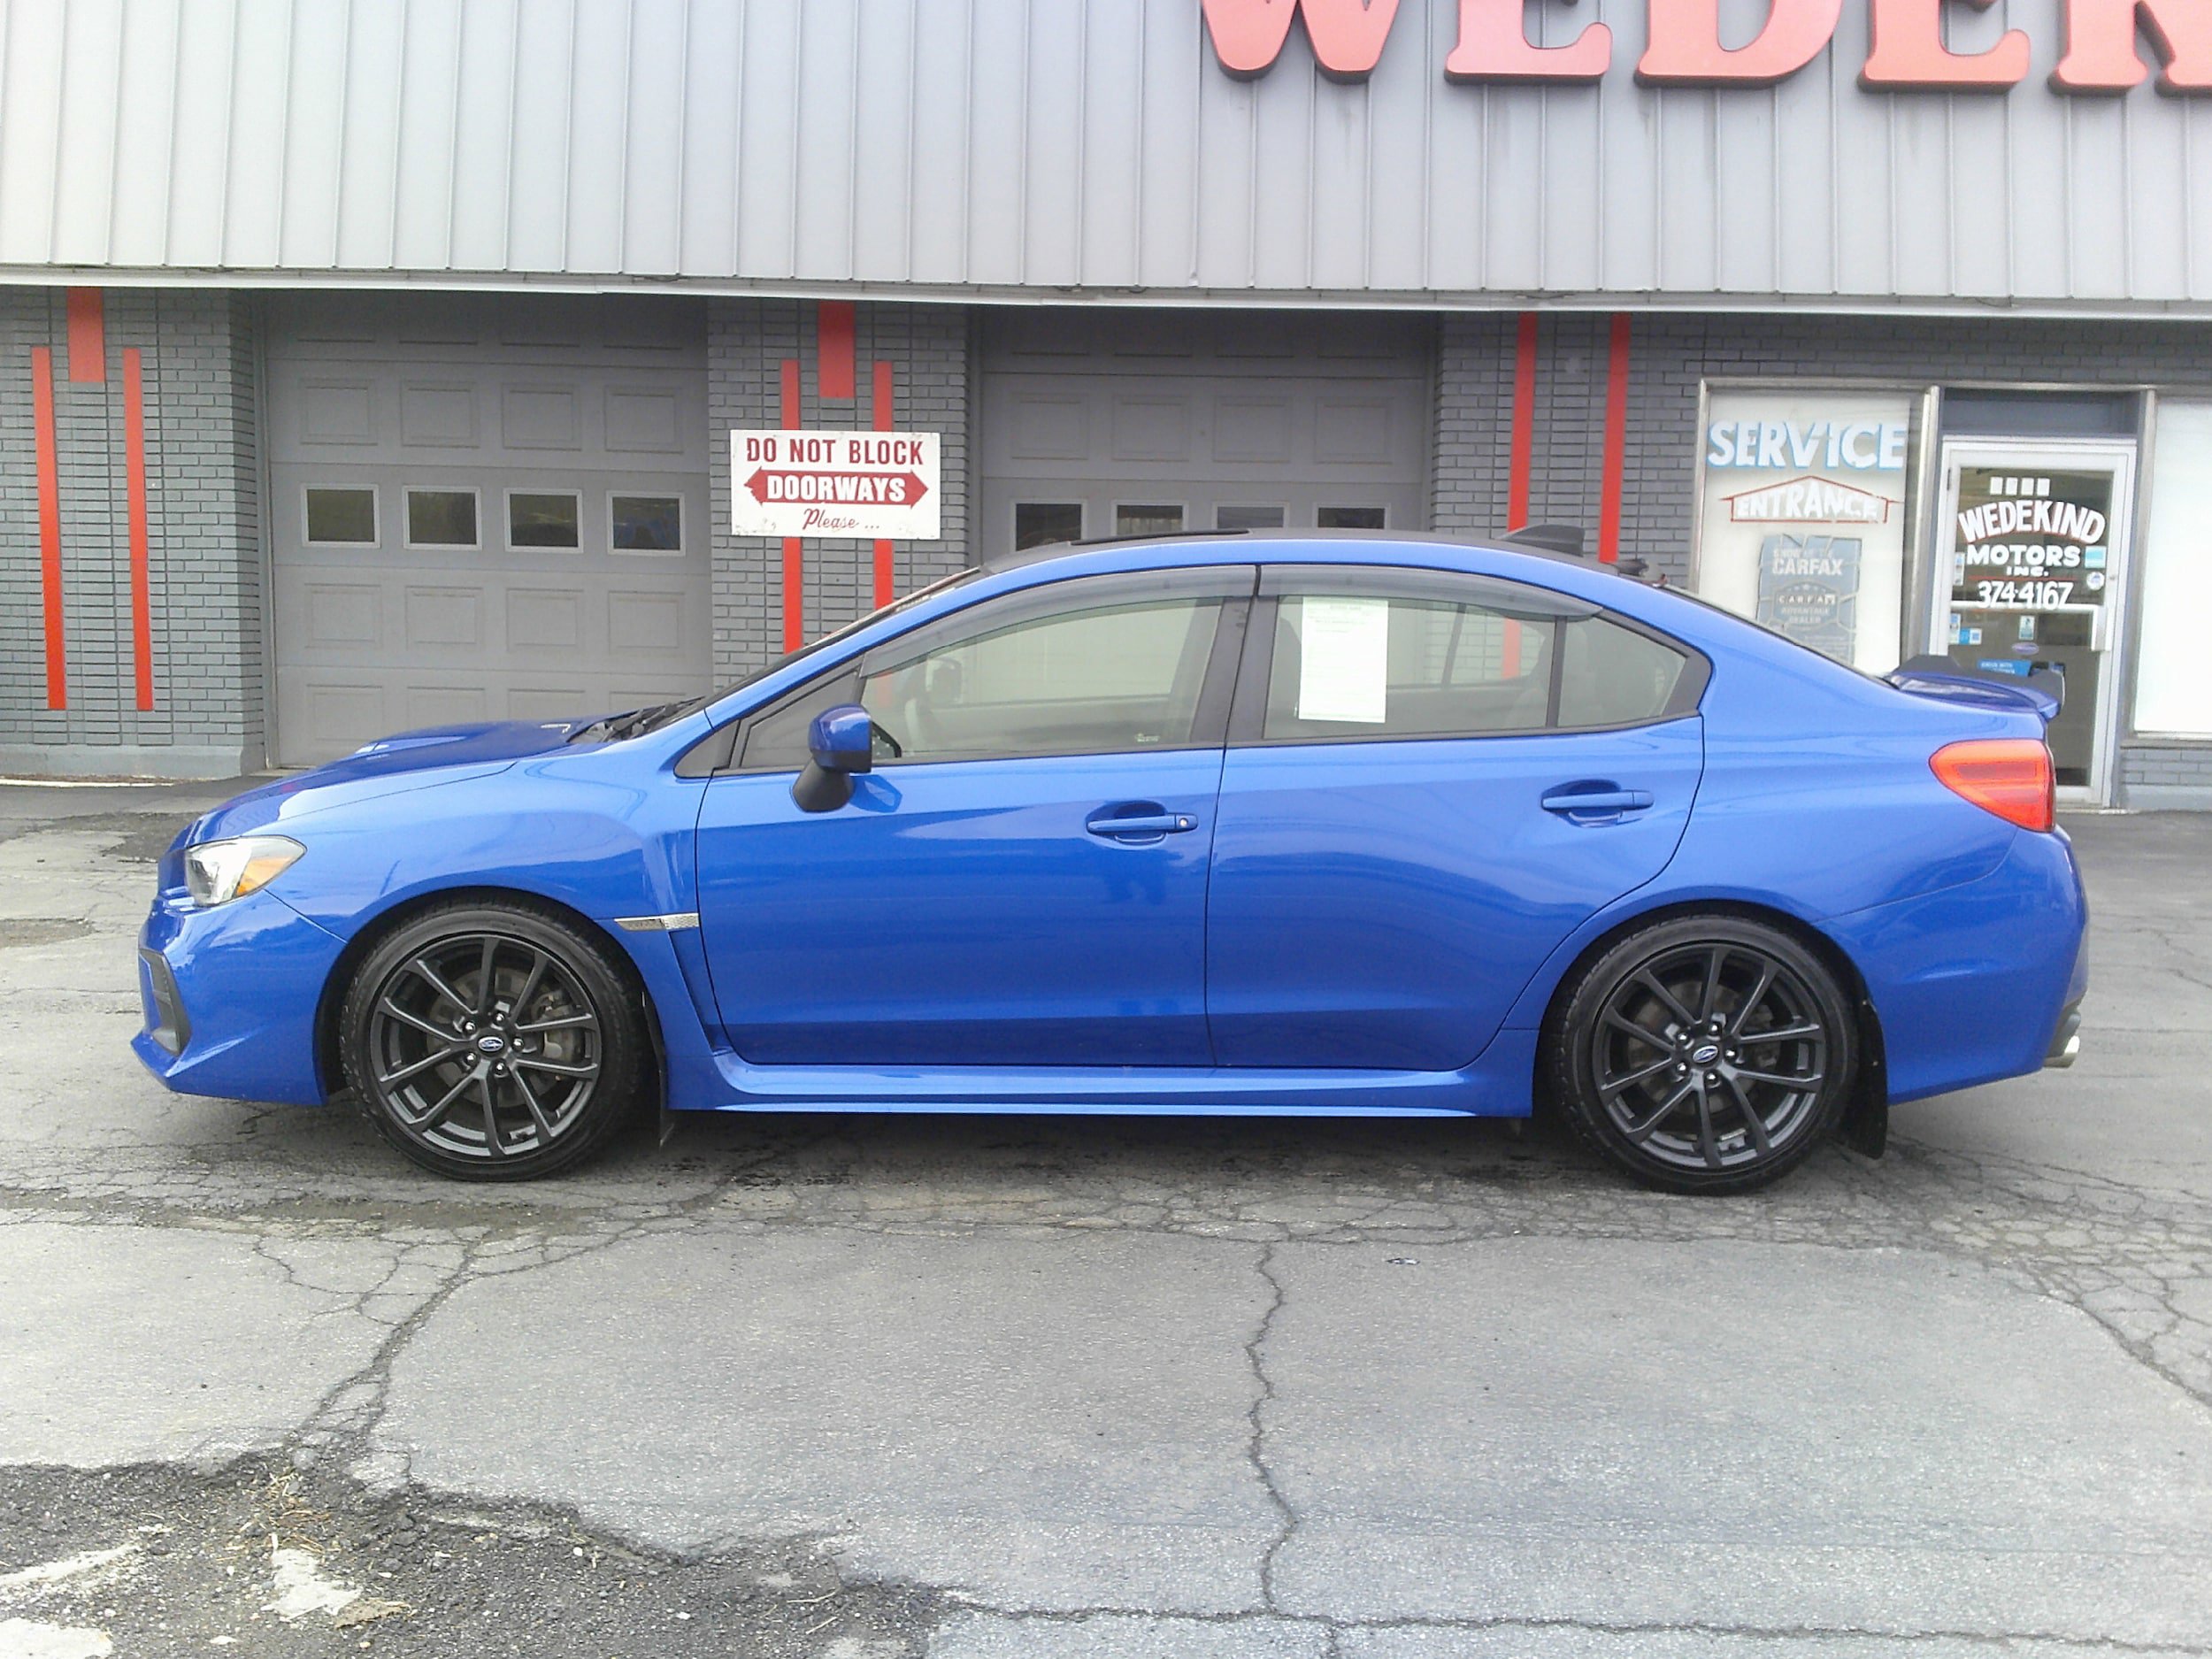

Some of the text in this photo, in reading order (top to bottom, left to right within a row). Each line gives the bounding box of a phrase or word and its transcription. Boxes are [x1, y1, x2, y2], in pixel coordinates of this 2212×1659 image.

[747, 438, 924, 465] DO NOT BLOCK
[1707, 421, 1907, 469] SERVICE
[766, 475, 906, 502] DOORWAYS
[1737, 482, 1879, 518] ENTRANCE
[802, 508, 860, 530] Please
[1957, 499, 2106, 545] WEDEKIND
[1772, 558, 1843, 576] CARFAX
[1966, 544, 2081, 567] MOTORS
[2006, 566, 2049, 578] INC.
